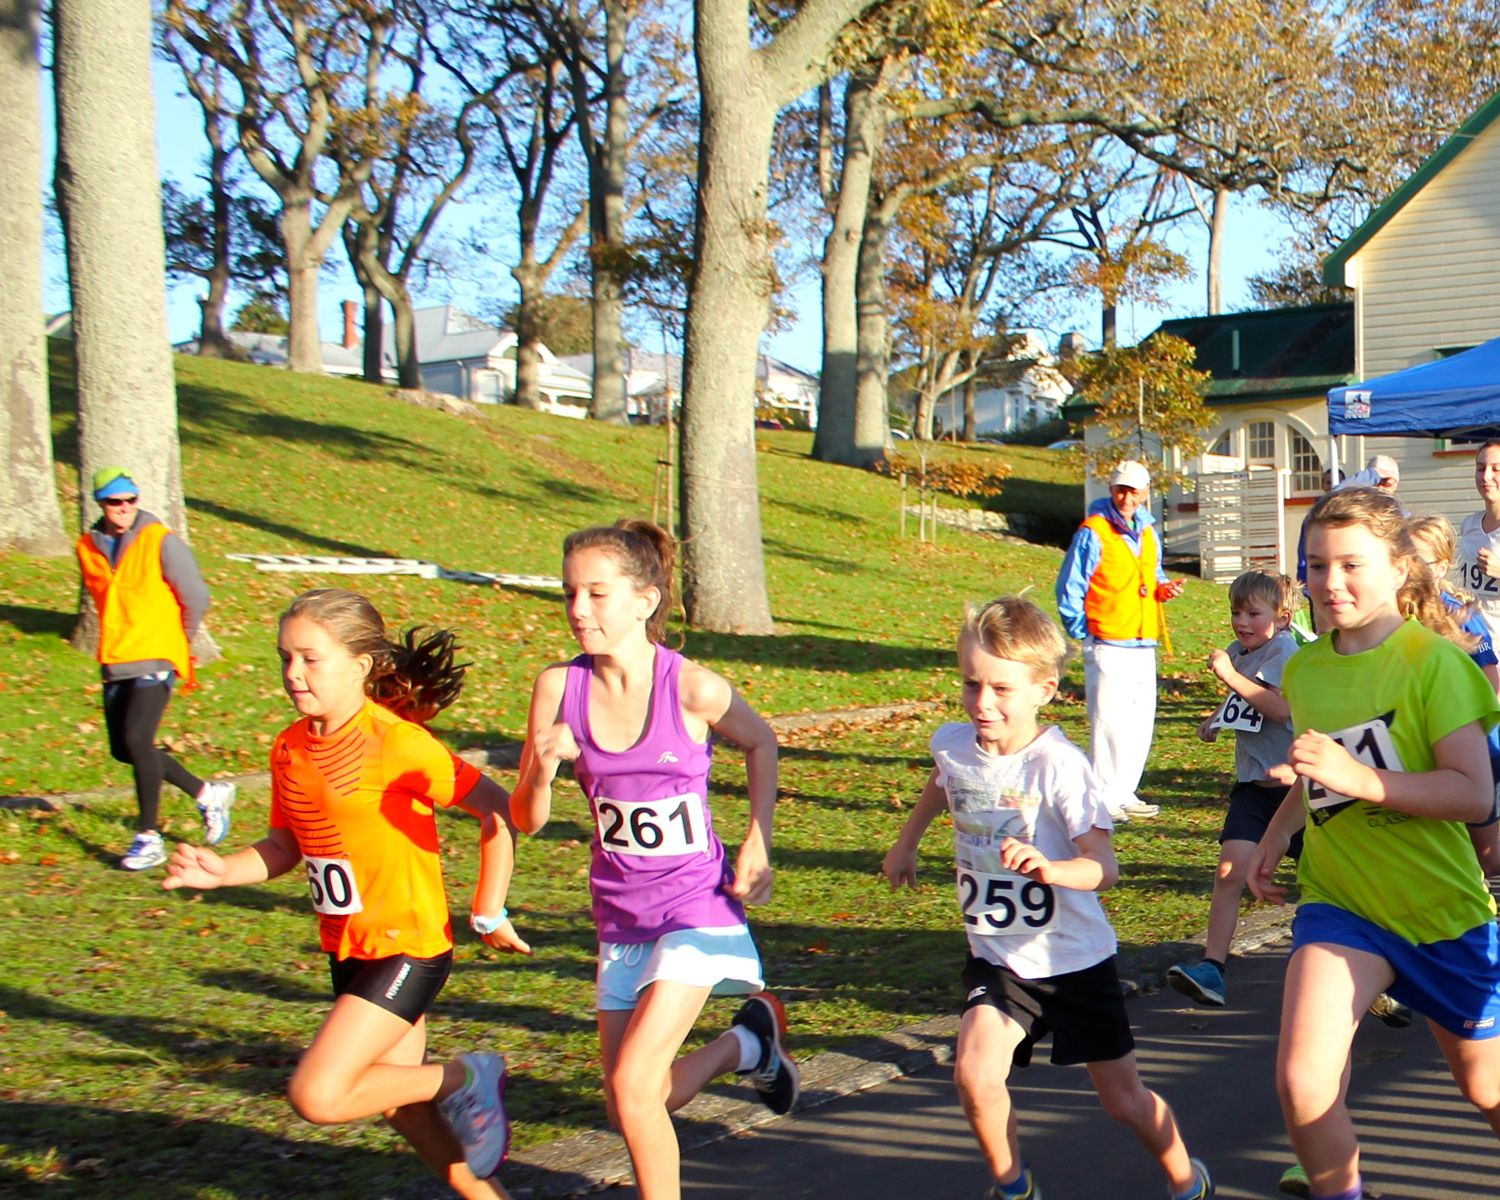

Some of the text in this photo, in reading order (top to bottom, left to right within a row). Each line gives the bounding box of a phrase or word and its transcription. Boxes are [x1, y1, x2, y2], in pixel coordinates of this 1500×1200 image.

[1215, 694, 1261, 727] 64
[598, 800, 694, 850] 261
[960, 873, 1055, 929] 259
